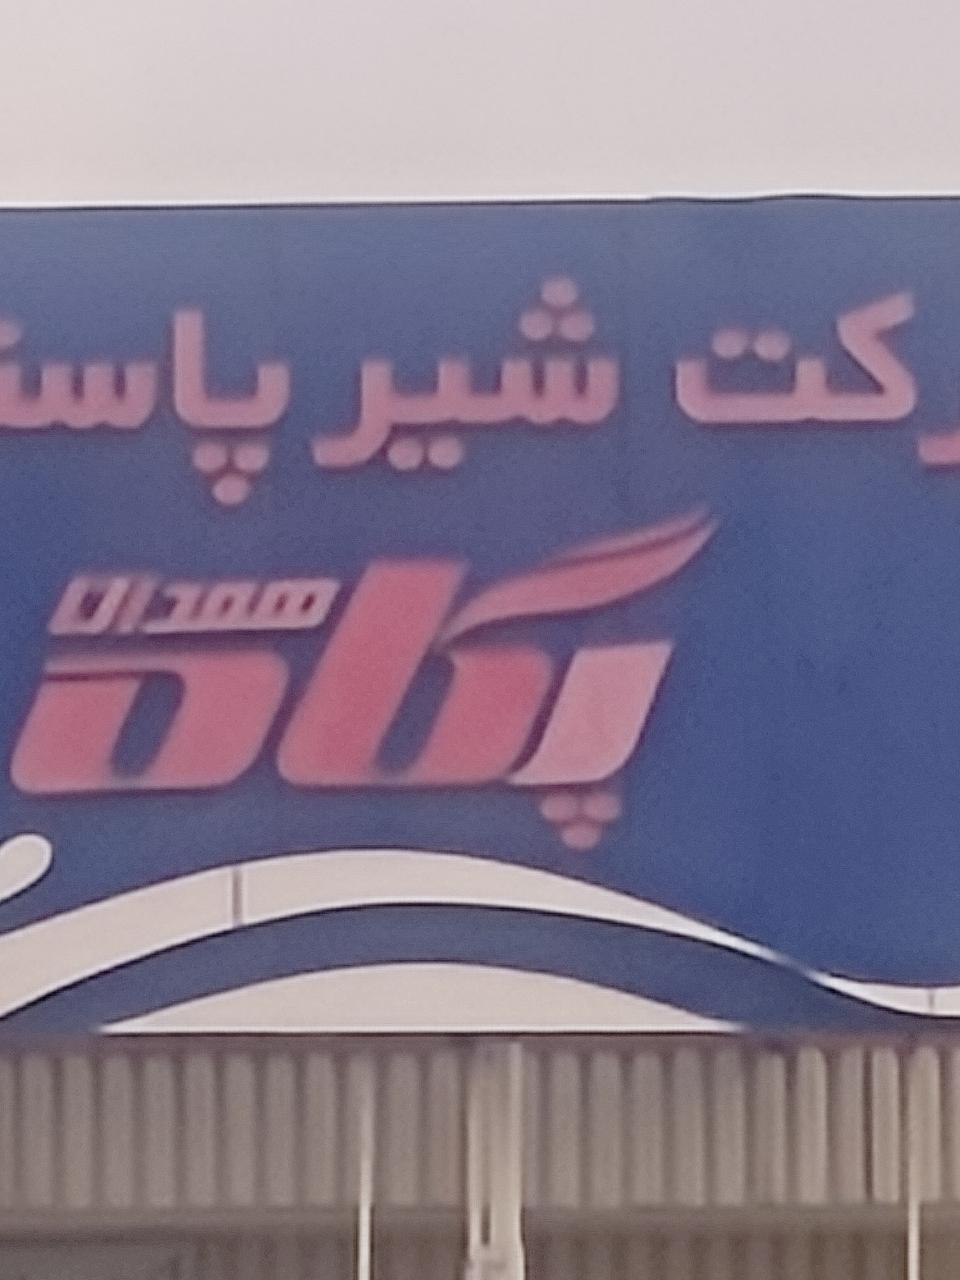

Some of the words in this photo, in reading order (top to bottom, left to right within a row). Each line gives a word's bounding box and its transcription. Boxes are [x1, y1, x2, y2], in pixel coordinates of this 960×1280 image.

[312, 276, 618, 467] شیر
[9, 510, 720, 850] پگاه
[48, 572, 342, 636] همدان
